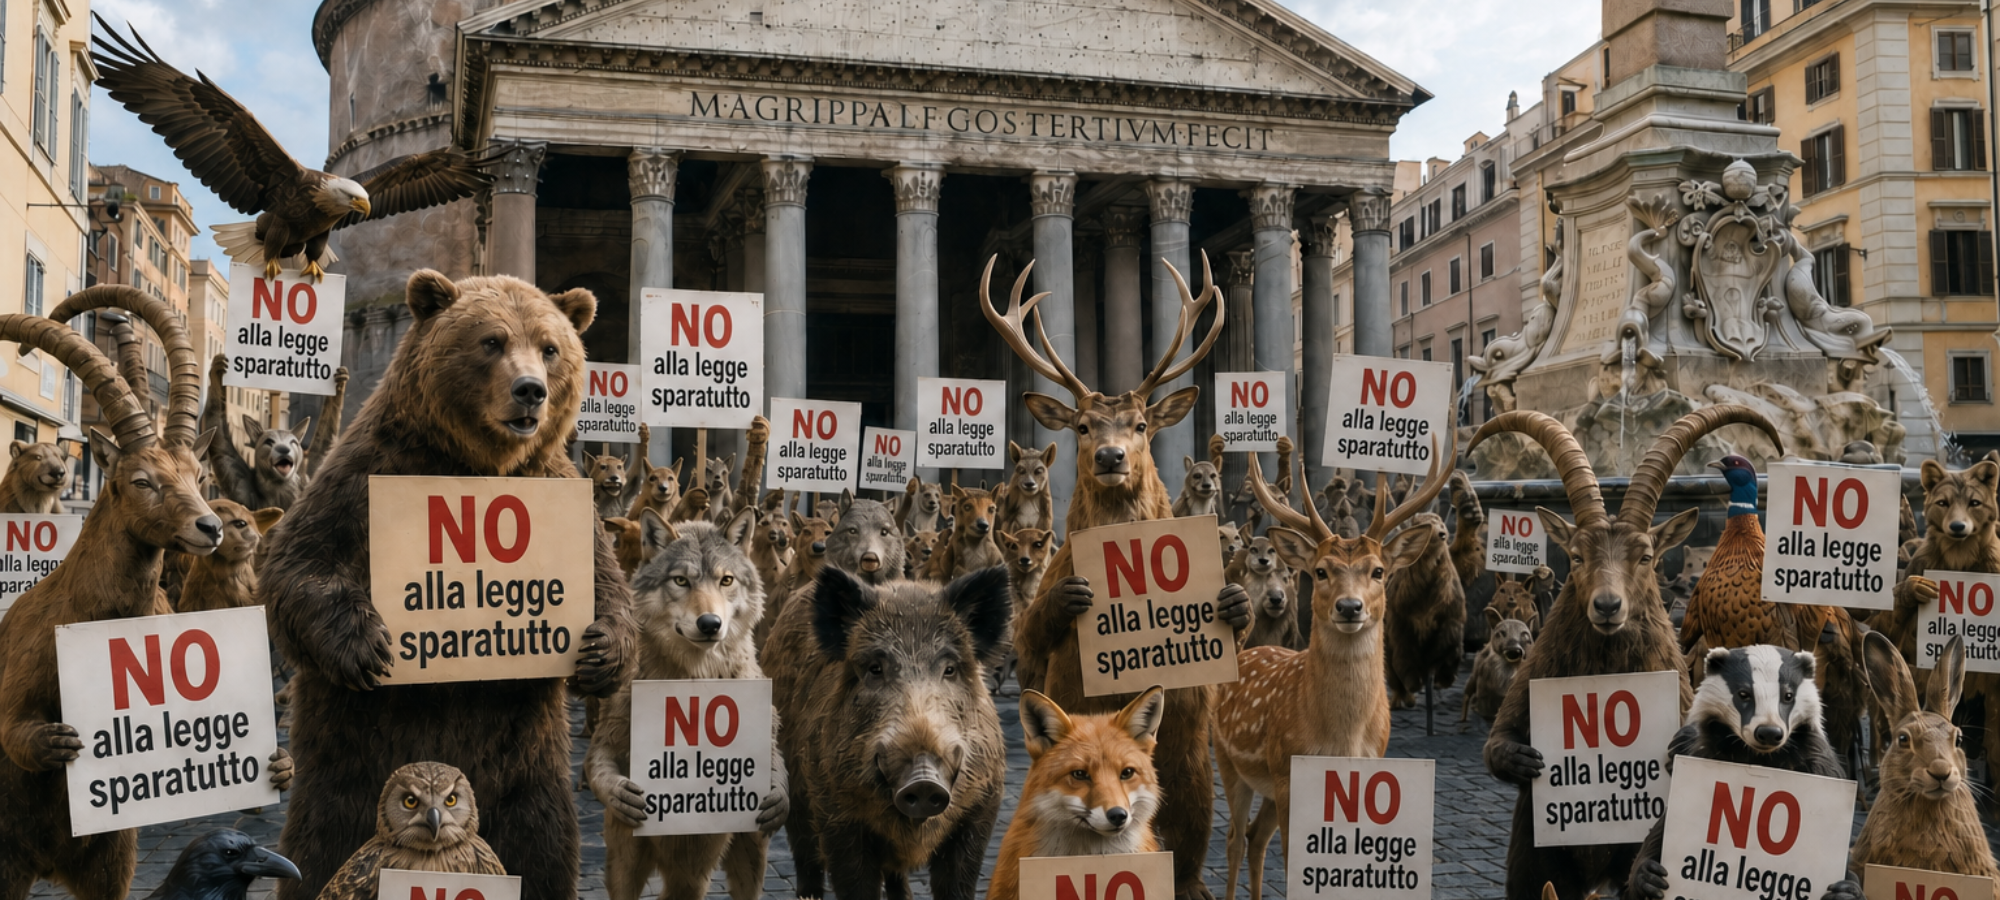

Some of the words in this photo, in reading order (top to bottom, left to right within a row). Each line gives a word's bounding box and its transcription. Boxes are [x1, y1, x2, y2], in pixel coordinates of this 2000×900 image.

[252, 277, 318, 325] NO
[238, 323, 272, 347] alla
[279, 326, 328, 354] legge
[671, 302, 733, 349] NO
[234, 355, 331, 381] sparatutto
[590, 370, 628, 398] NO
[654, 350, 689, 376] alla
[696, 351, 748, 385] legge
[651, 385, 751, 413] sparatutto
[941, 386, 983, 416] NO
[1231, 381, 1269, 408] NO
[1360, 368, 1417, 409] NO
[580, 397, 601, 413] alla
[604, 399, 635, 418] legge
[792, 409, 838, 440] NO
[1224, 411, 1244, 425] alla
[1246, 411, 1277, 429] legge
[1342, 409, 1374, 430] alla
[1380, 411, 1429, 438] legge
[577, 418, 636, 434] sparatutto
[929, 418, 953, 436] alla
[959, 418, 994, 440] legge
[1223, 429, 1278, 443] sparatutto
[779, 440, 806, 460] alla
[809, 442, 847, 465] legge
[875, 434, 902, 456] NO
[928, 438, 995, 459] sparatutto
[1337, 435, 1429, 461] sparatutto
[777, 463, 847, 484] sparatutto
[1793, 476, 1869, 529] NO
[6, 521, 57, 552] NO
[428, 495, 530, 563] NO
[1493, 536, 1510, 550] alla
[1501, 514, 1533, 538] NO
[1103, 534, 1189, 598] NO
[1778, 531, 1815, 557] alla
[1823, 532, 1882, 567] legge
[404, 571, 465, 610] alla
[476, 570, 564, 616] legge
[1774, 566, 1883, 593] sparatutto
[1939, 580, 1994, 617] NO
[1096, 603, 1141, 635] alla
[1147, 599, 1214, 633] legge
[1928, 617, 1957, 636] alla
[400, 620, 571, 669] sparatutto
[1096, 633, 1223, 679] sparatutto
[109, 629, 221, 710] NO
[93, 715, 153, 758] alla
[164, 711, 249, 754] legge
[664, 695, 739, 747] NO
[1562, 689, 1641, 749] NO
[89, 751, 259, 815] sparatutto
[649, 751, 688, 779] alla
[696, 751, 755, 784] legge
[1550, 755, 1592, 787] alla
[1598, 754, 1660, 790] legge
[646, 786, 759, 821] sparatutto
[1324, 770, 1401, 825] NO
[1546, 792, 1664, 831] sparatutto
[1706, 781, 1801, 856] NO
[1306, 827, 1346, 854] alla
[1355, 828, 1416, 862] legge
[1303, 863, 1418, 894] sparatutto
[1681, 848, 1729, 886] alla
[1736, 855, 1811, 900] legge
